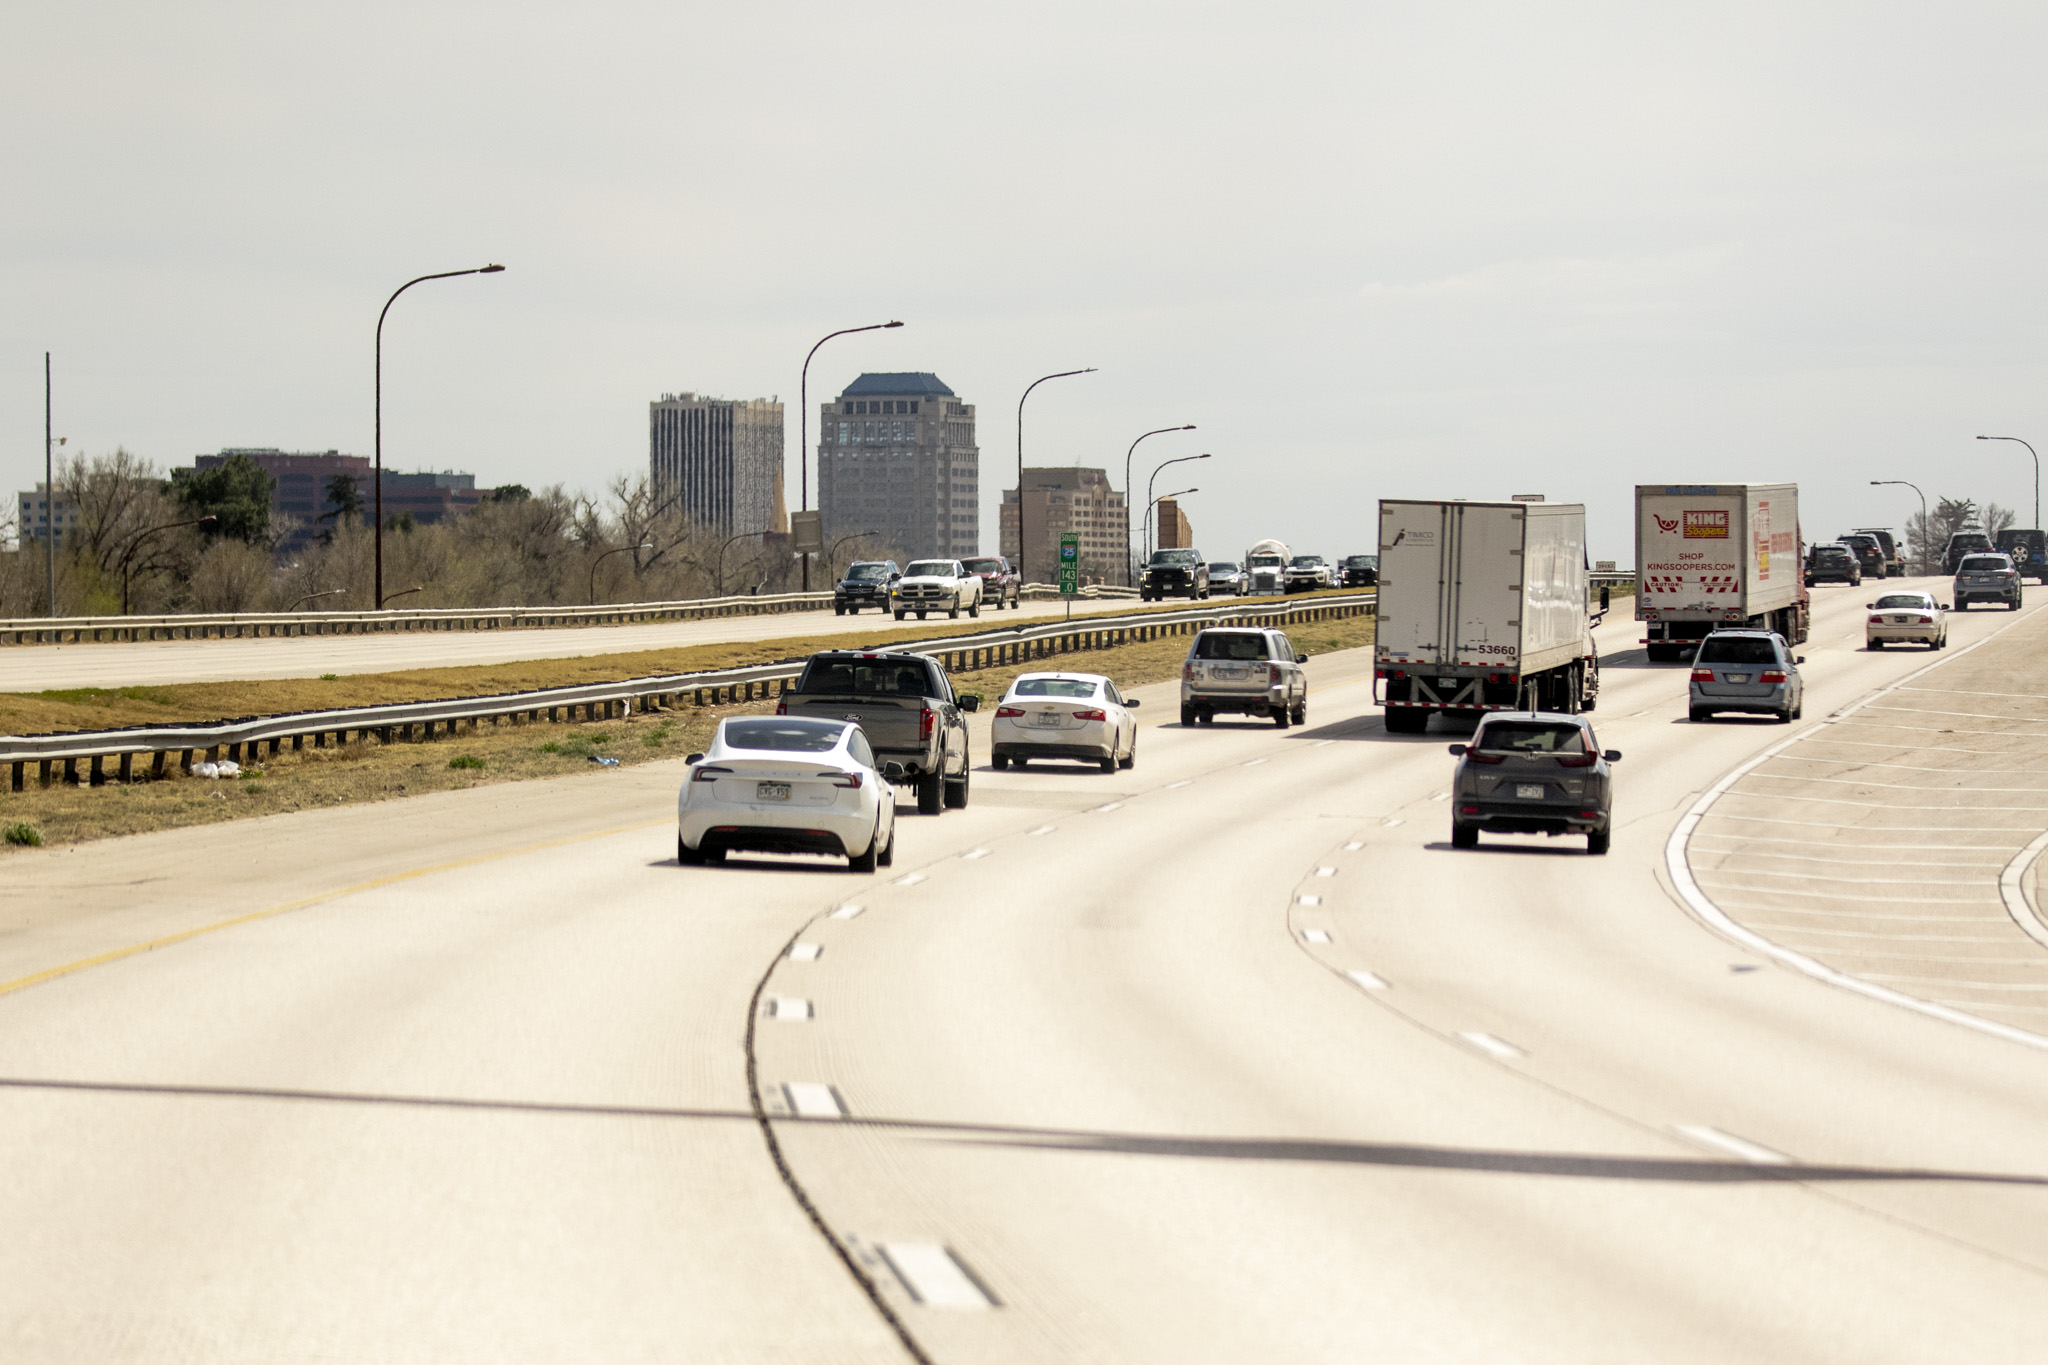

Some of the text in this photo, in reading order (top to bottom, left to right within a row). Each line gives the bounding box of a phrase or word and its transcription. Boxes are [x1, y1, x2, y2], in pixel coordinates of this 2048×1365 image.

[1686, 513, 1726, 525] KING
[1686, 525, 1726, 538] Soopers
[1061, 533, 1078, 542] SOUTH
[1064, 548, 1075, 557] 25
[1678, 552, 1705, 560] SHOP
[1060, 562, 1077, 570] MILE
[1647, 563, 1736, 571] KINGSOOPERS.COM
[1061, 570, 1076, 580] 143
[1478, 645, 1516, 655] 53660
